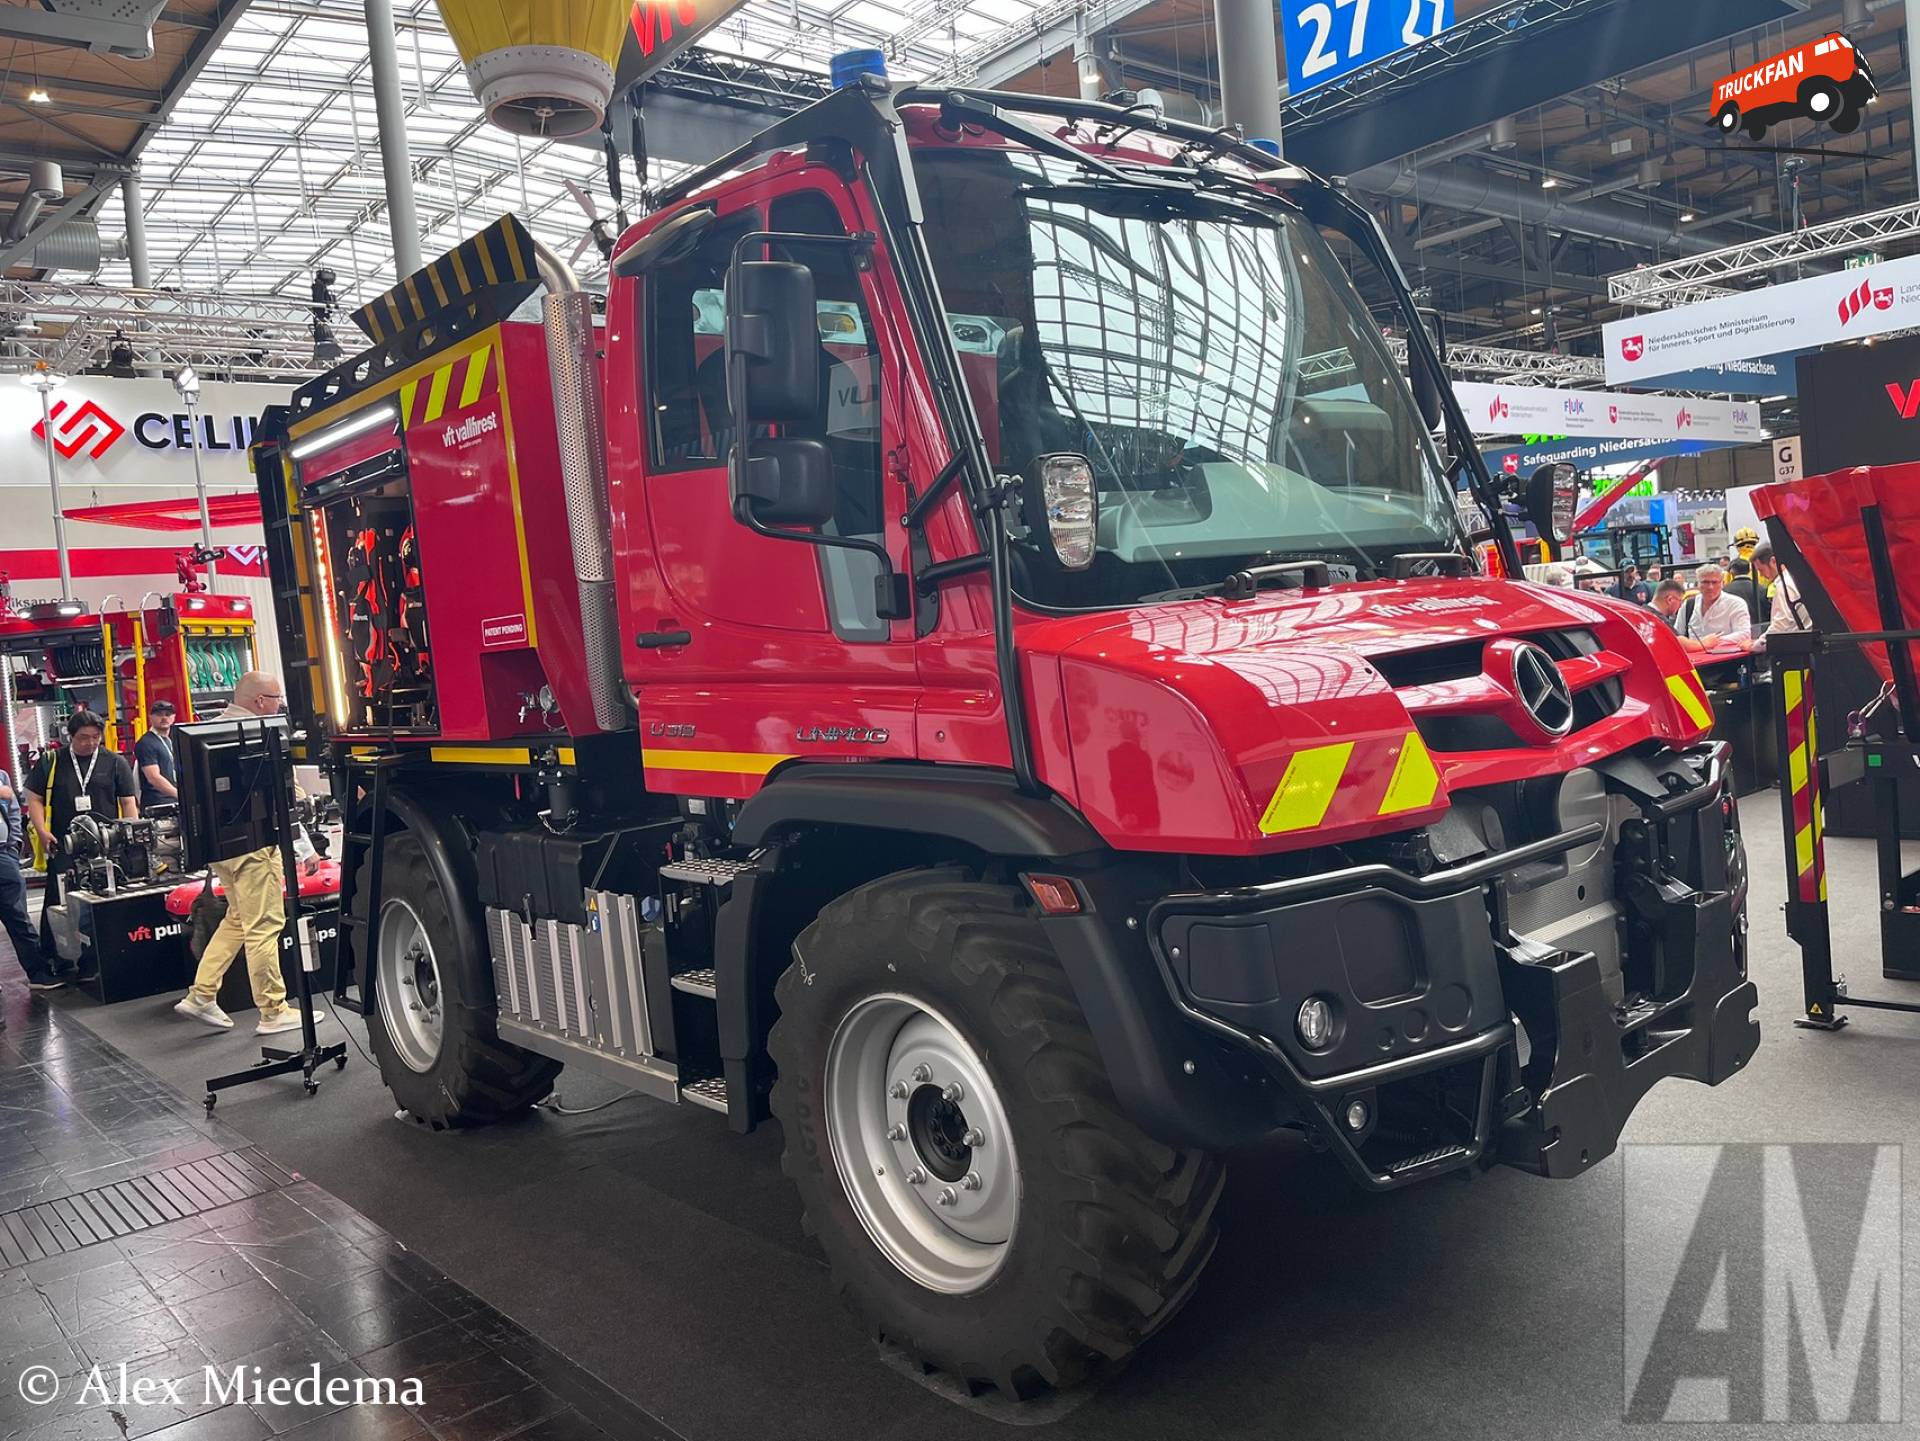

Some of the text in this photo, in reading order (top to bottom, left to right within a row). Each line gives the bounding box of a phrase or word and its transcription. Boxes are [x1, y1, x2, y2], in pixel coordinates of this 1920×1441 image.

[1297, 0, 1371, 79] 27
[1648, 313, 1768, 345] Niedersächsisches Ministerium
[1661, 338, 1692, 350] Inneres,
[1693, 333, 1716, 344] Sport
[1717, 328, 1733, 339] und
[1734, 316, 1796, 336] Digitalisierung
[133, 413, 260, 450] CELI
[1523, 446, 1597, 466] Safeguarding
[1779, 446, 1793, 463] G
[1779, 465, 1795, 475] G37
[796, 727, 890, 744] UNIMOG
[154, 923, 181, 940] pu
